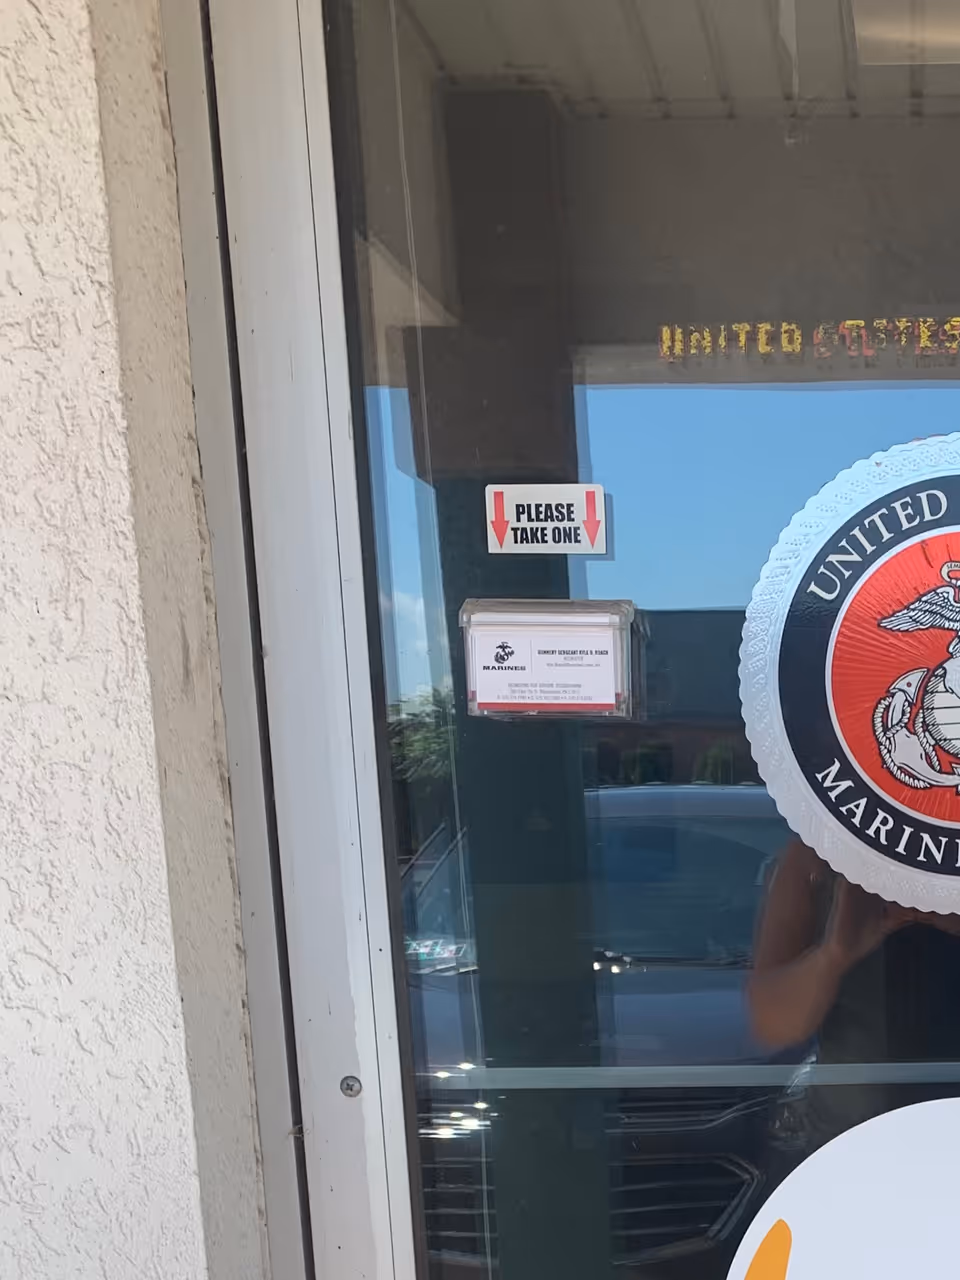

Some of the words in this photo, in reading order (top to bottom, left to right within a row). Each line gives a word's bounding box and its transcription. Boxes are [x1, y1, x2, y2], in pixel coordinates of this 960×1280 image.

[515, 503, 575, 523] PLEASE
[511, 527, 548, 545] TAKE
[552, 526, 581, 544] ONE
[806, 488, 948, 601] UNITED
